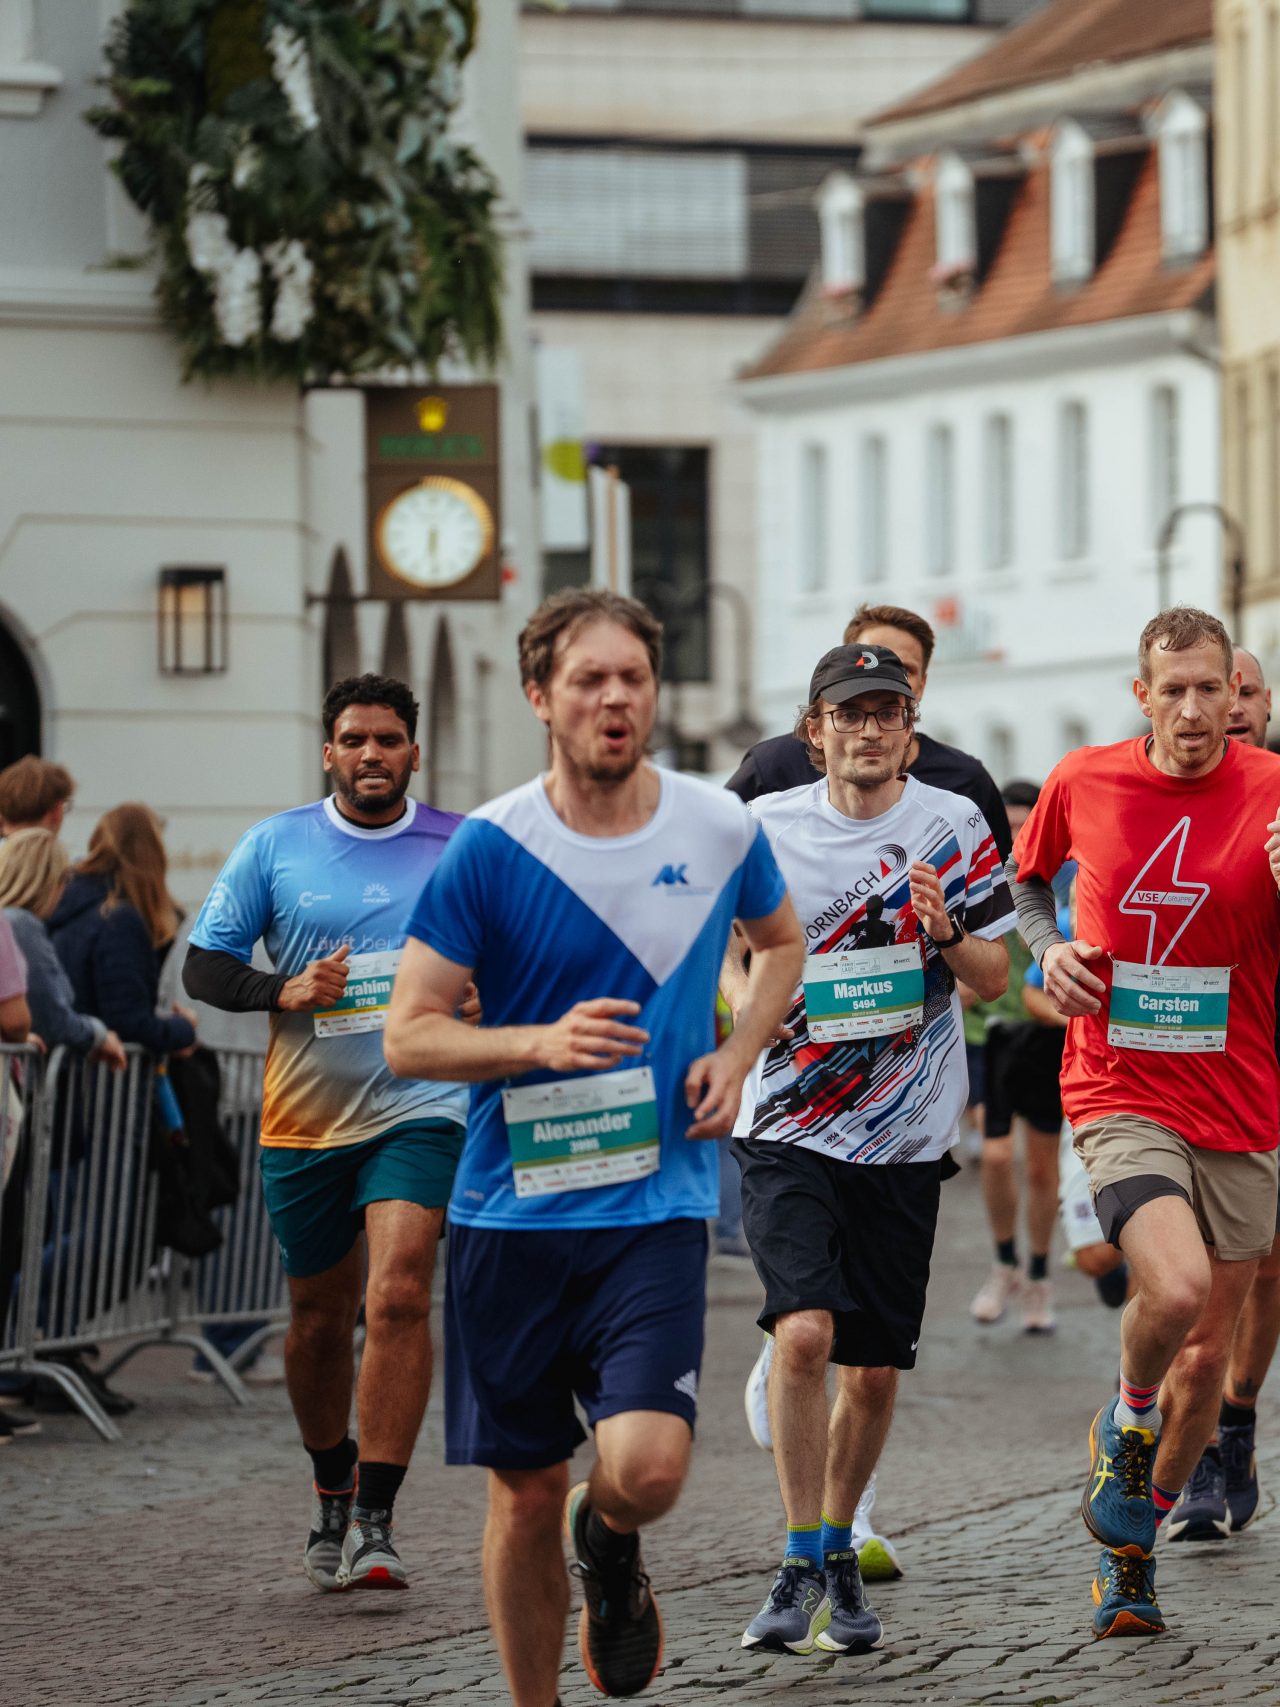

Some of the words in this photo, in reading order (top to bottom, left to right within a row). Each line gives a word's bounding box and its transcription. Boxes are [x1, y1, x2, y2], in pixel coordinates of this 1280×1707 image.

[1137, 892, 1160, 903] VSE
[362, 934, 392, 951] bei
[833, 980, 894, 1000] Markus
[852, 999, 877, 1011] 5494
[1138, 994, 1200, 1012] Carsten
[1153, 1014, 1183, 1025] 12448
[533, 1111, 633, 1144] Alexander
